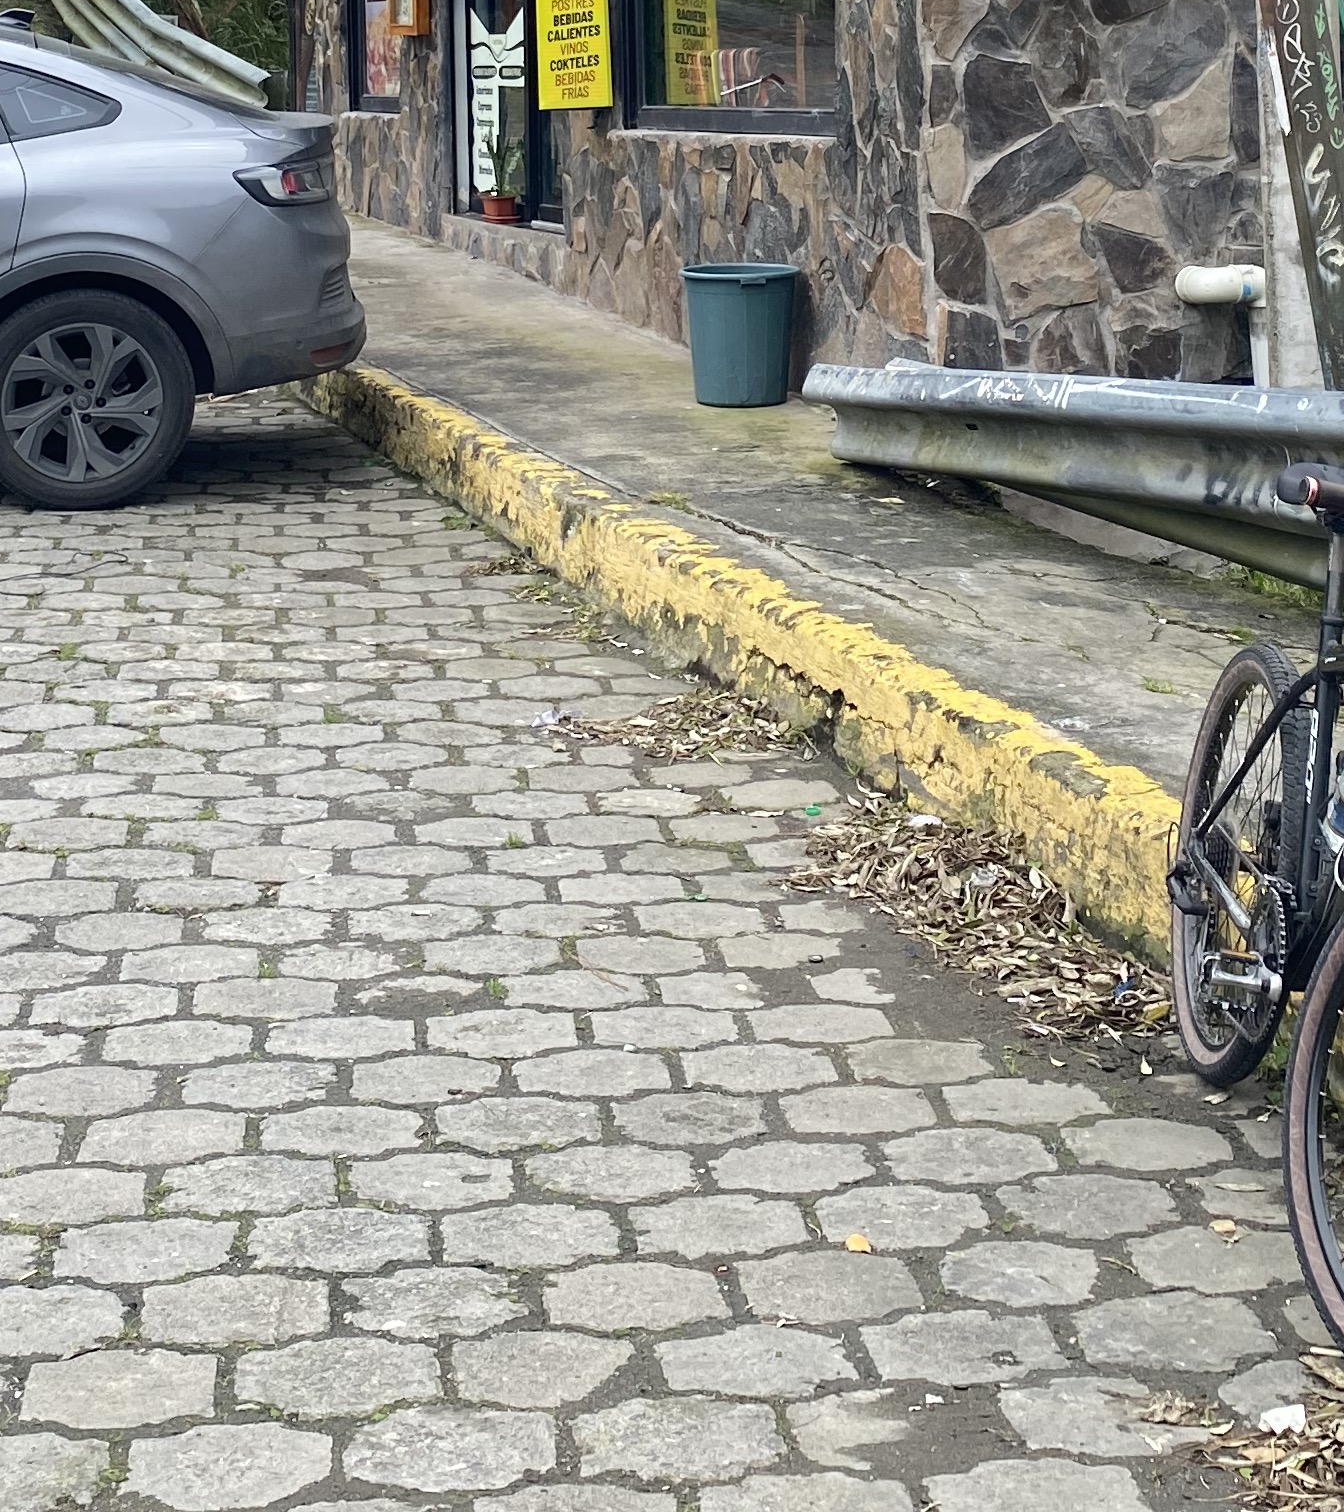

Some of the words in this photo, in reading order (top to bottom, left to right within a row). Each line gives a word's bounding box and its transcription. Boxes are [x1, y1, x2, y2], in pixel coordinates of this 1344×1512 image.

[553, 10, 594, 27] BEBIDAS
[547, 25, 601, 42] CALIENTES
[560, 41, 589, 56] VINOS
[550, 54, 600, 72] COKTELES
[555, 70, 596, 87] BEBIDAS
